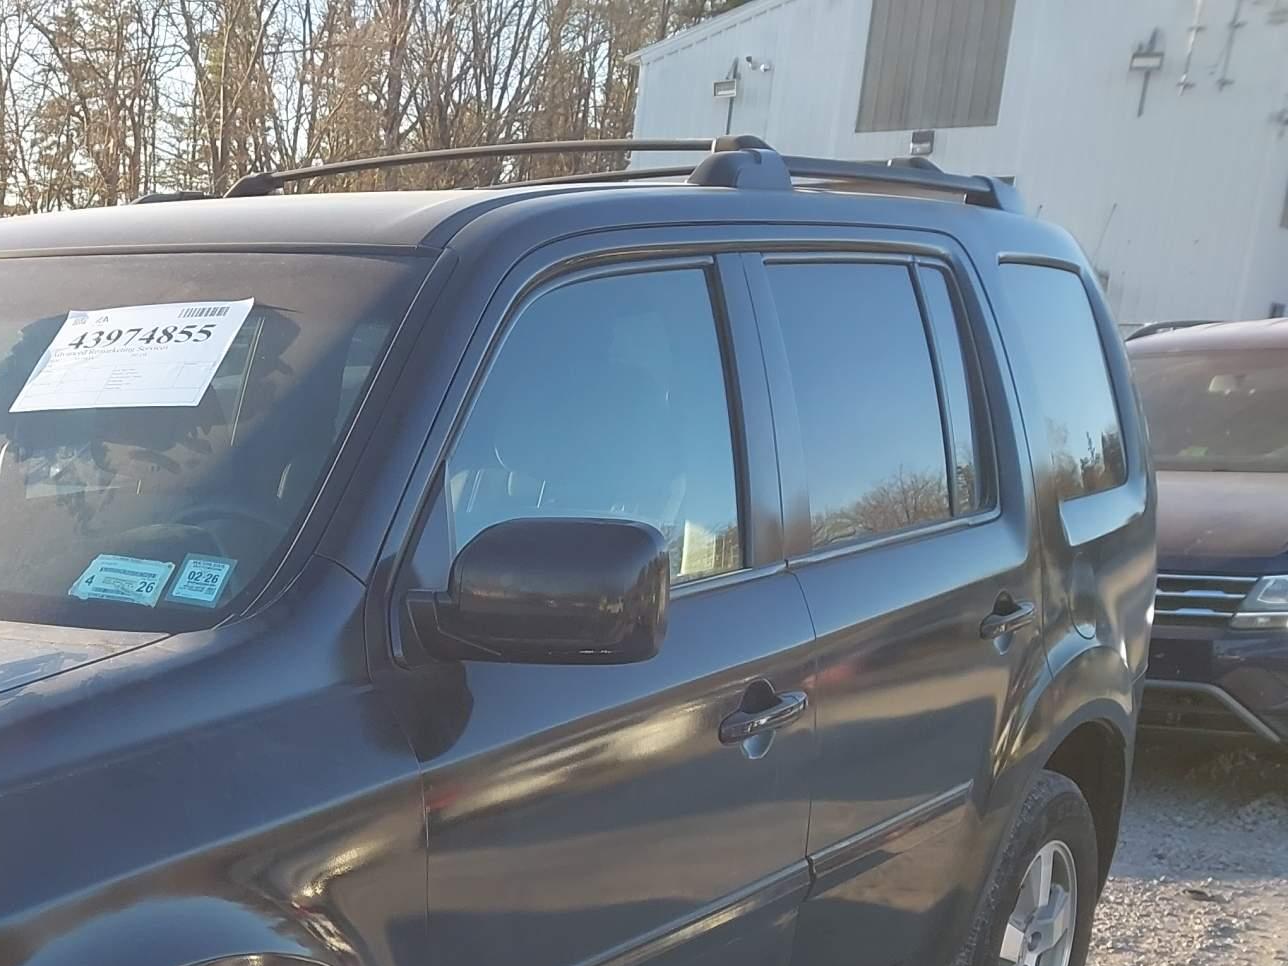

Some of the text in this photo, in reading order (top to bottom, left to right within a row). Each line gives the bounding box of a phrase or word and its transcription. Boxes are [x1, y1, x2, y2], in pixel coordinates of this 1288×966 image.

[68, 324, 217, 349] 43974855
[85, 574, 96, 587] 4
[136, 581, 156, 594] 26
